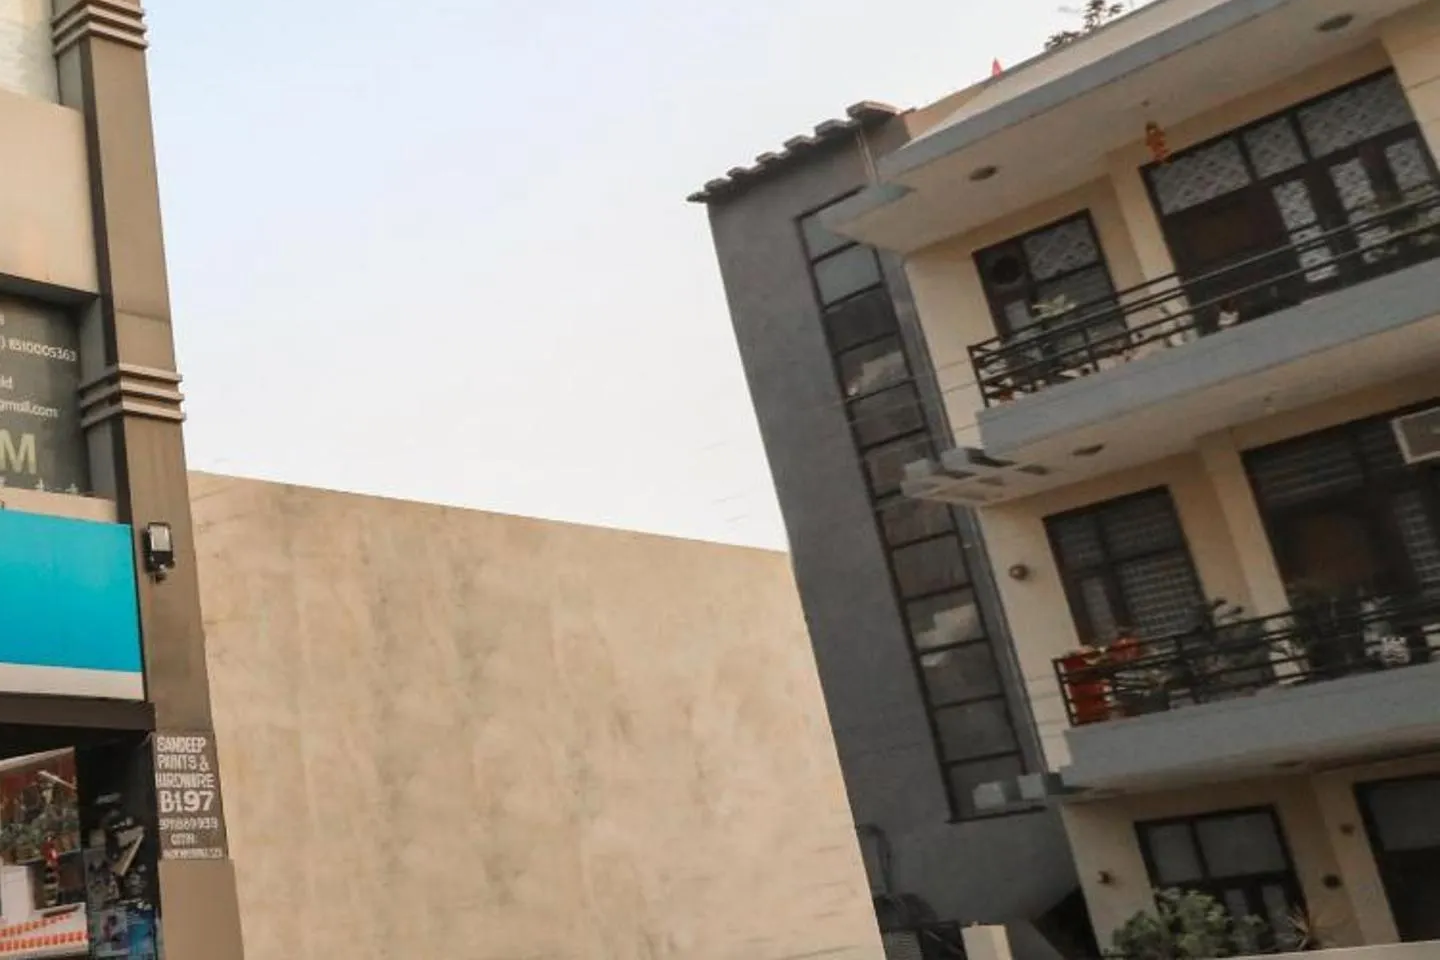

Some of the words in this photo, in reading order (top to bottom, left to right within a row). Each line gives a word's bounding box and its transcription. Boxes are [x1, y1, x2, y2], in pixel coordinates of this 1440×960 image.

[156, 735, 207, 754] SANDEEP
[199, 754, 211, 772] &
[160, 790, 214, 813] B197
